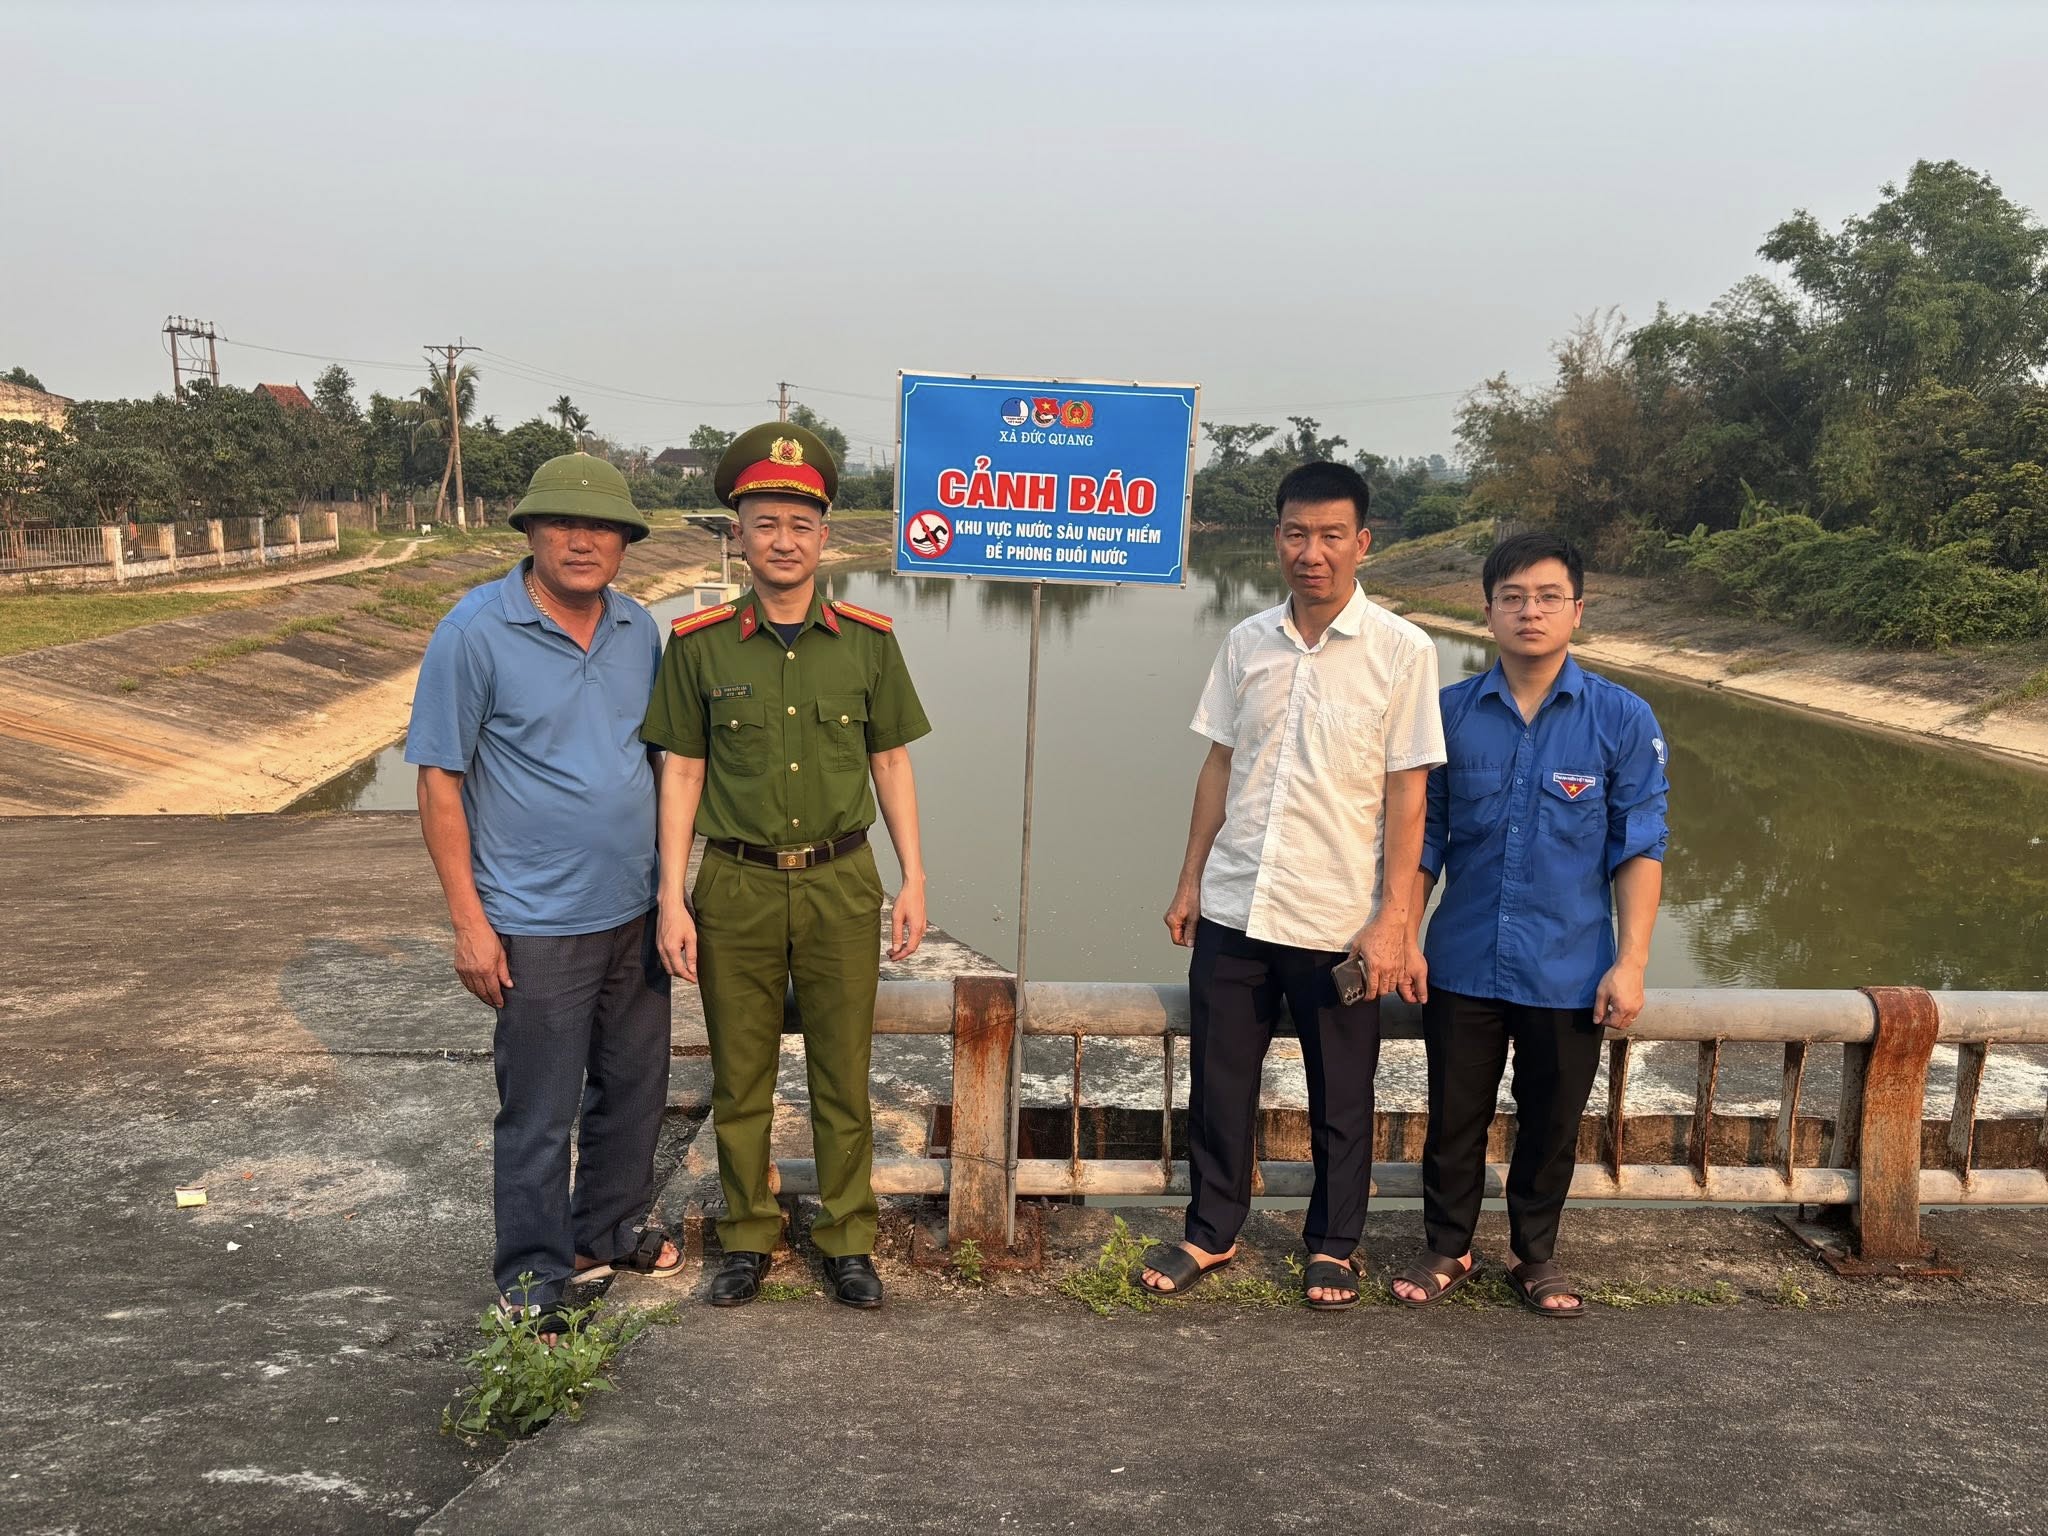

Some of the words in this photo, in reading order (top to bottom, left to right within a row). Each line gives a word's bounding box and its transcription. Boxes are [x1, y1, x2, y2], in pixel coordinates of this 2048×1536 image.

[1021, 429, 1045, 443] ĐỨC
[1048, 433, 1093, 446] QUANG
[938, 455, 1058, 511] CẢNH
[1067, 469, 1156, 516] BÁO
[955, 519, 983, 535] KHU
[986, 521, 1012, 539] VỰC
[1016, 520, 1053, 538] NƯỚC
[1056, 523, 1083, 540] SÂU
[1087, 526, 1123, 542] NGUY
[1127, 523, 1161, 543] HIỂM
[986, 540, 1003, 559] ĐỀ
[1007, 543, 1052, 562] PHÒNG
[1055, 544, 1087, 563] ĐUỐI
[1091, 547, 1128, 565] NƯỚC
